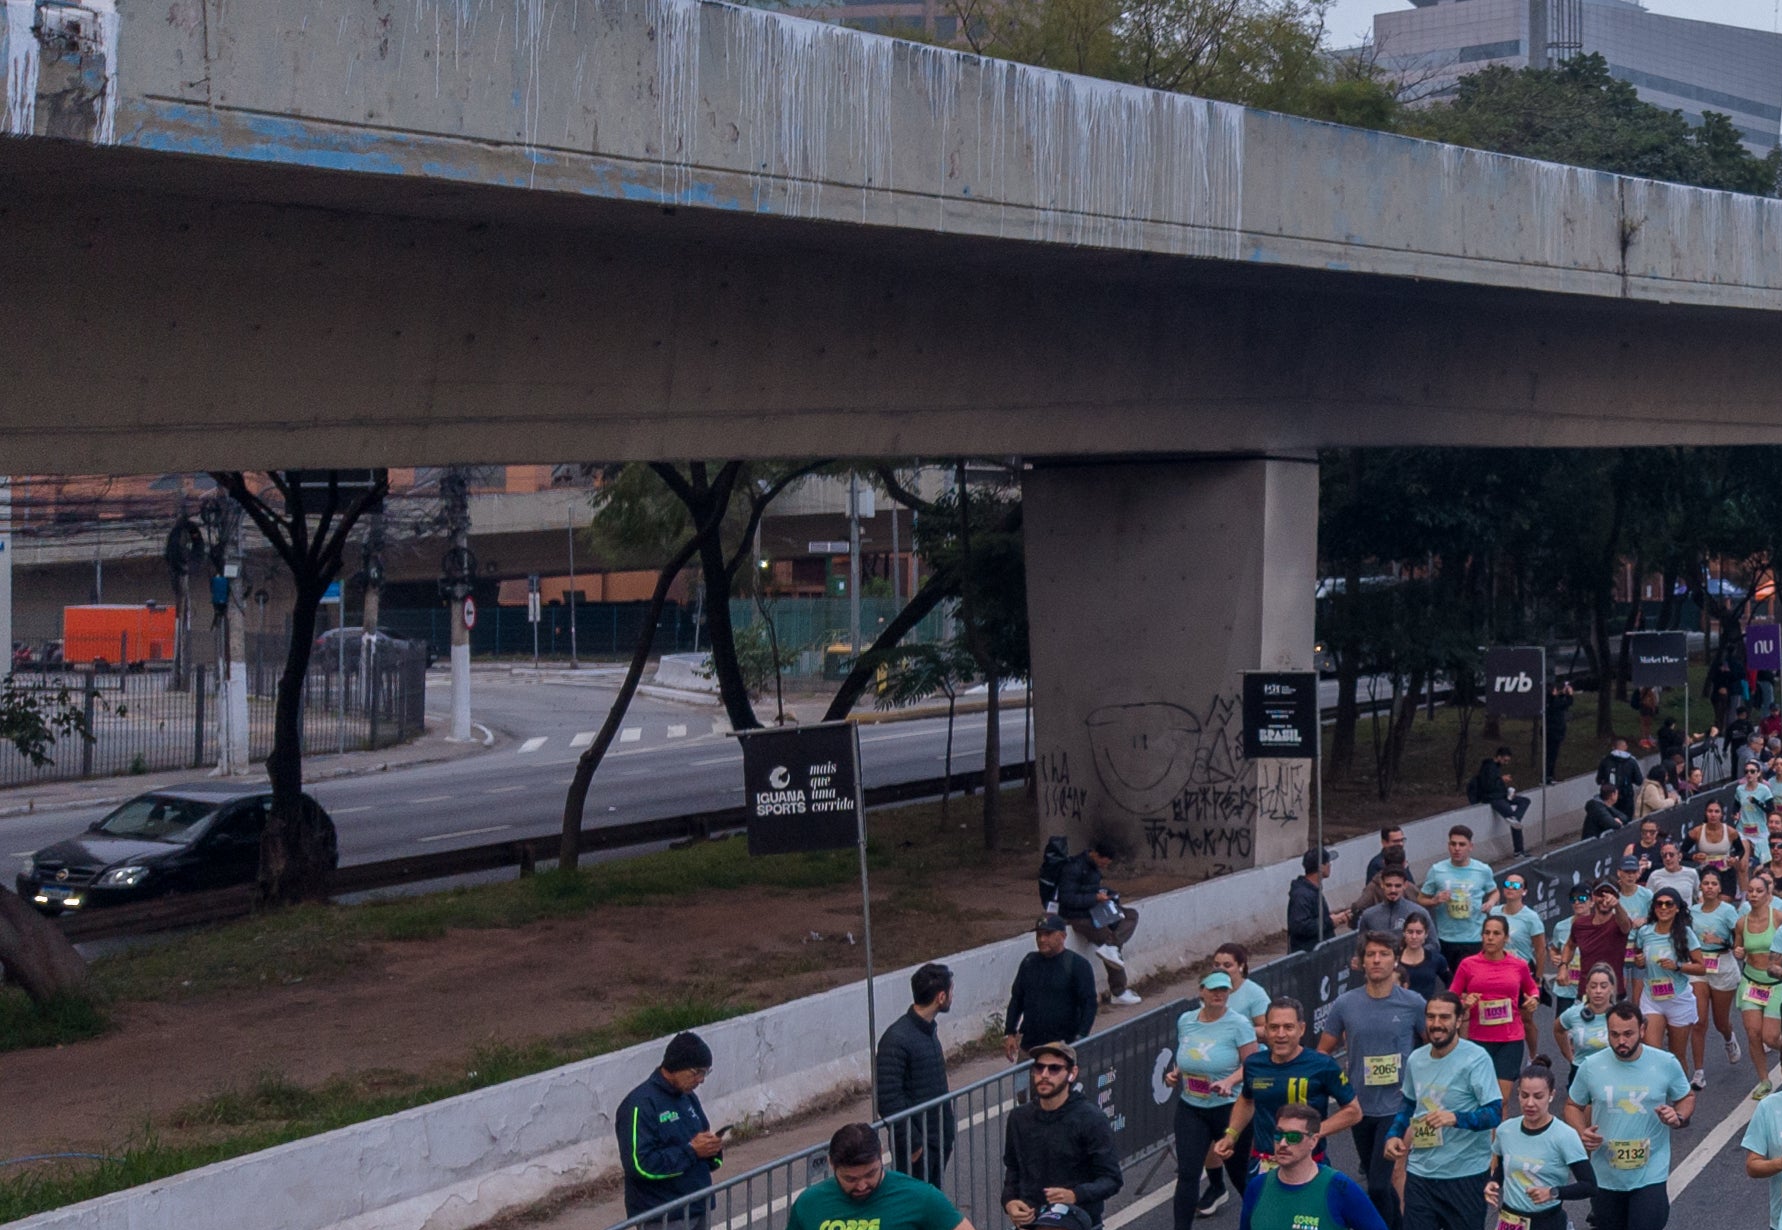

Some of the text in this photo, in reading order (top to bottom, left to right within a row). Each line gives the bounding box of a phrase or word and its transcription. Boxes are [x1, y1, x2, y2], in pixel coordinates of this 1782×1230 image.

[1495, 673, 1532, 694] rvb
[810, 761, 837, 775] mais
[810, 776, 831, 789] que
[756, 790, 806, 805] IGUANA
[811, 788, 836, 800] uma
[756, 802, 807, 816] SPORTS
[811, 797, 855, 812] corrida
[1373, 1064, 1397, 1076] 2065
[1617, 1148, 1645, 1160] 2132
